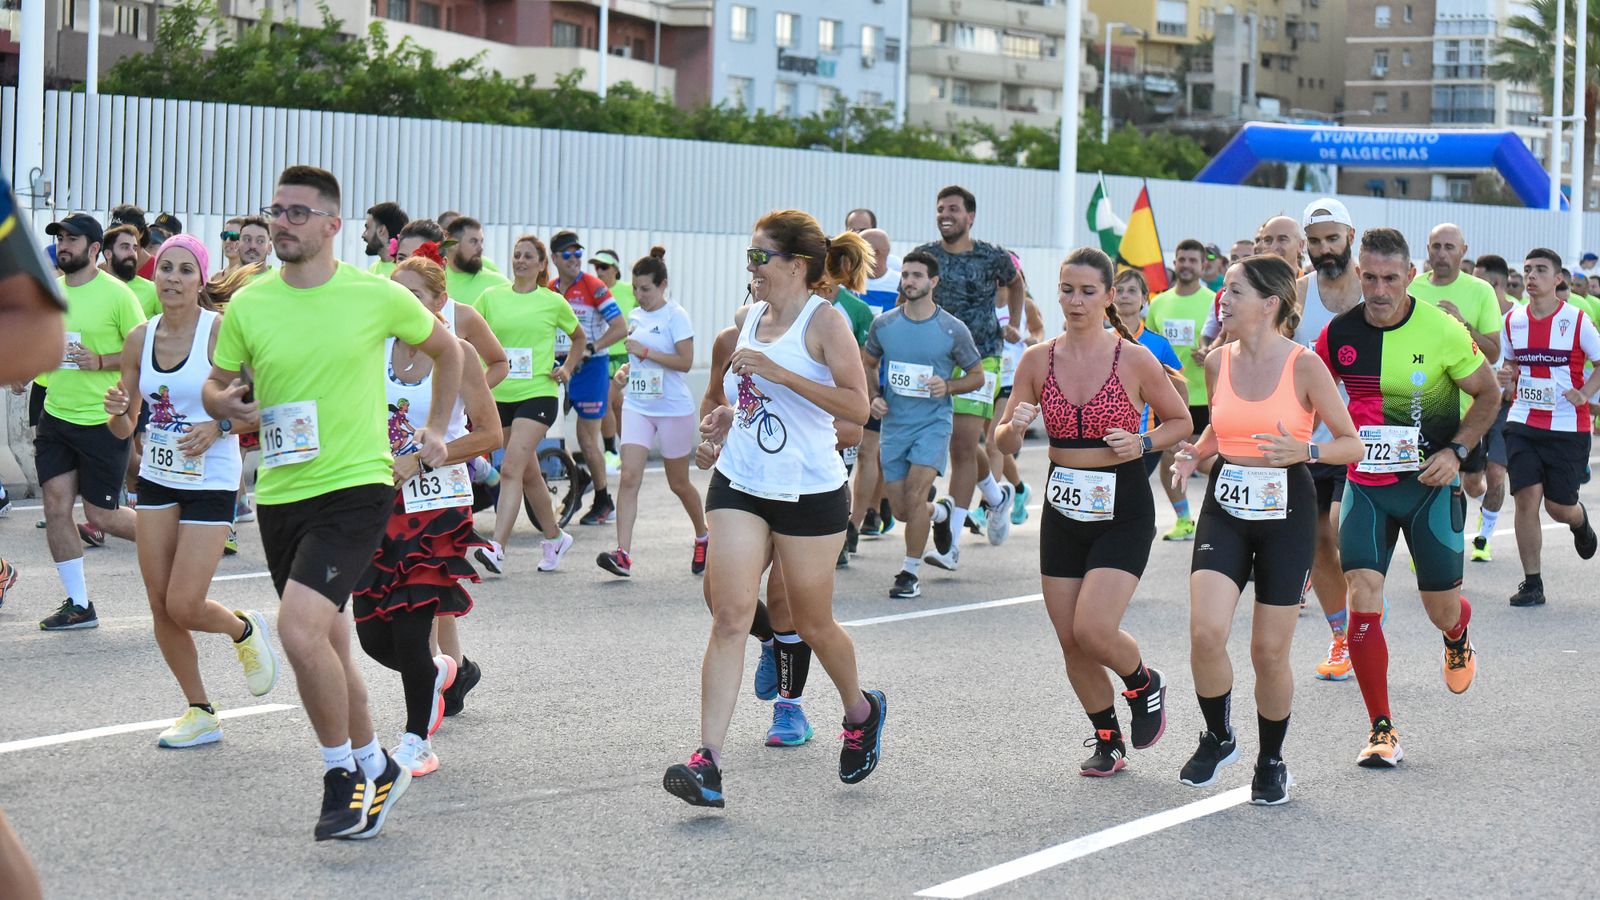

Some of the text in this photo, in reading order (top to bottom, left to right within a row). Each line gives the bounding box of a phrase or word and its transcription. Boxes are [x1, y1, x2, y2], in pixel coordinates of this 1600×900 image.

[1310, 131, 1440, 144] AYUNTAMIENTO
[1319, 146, 1429, 161] DE ALGECIRAS
[631, 380, 646, 392] 119
[891, 373, 910, 387] 558
[1519, 387, 1542, 401] 1558
[265, 427, 283, 451] 116
[150, 446, 173, 467] 158
[1365, 443, 1391, 460] 722
[409, 476, 441, 498] 163
[1052, 485, 1081, 506] 245
[1220, 483, 1249, 505] 241
